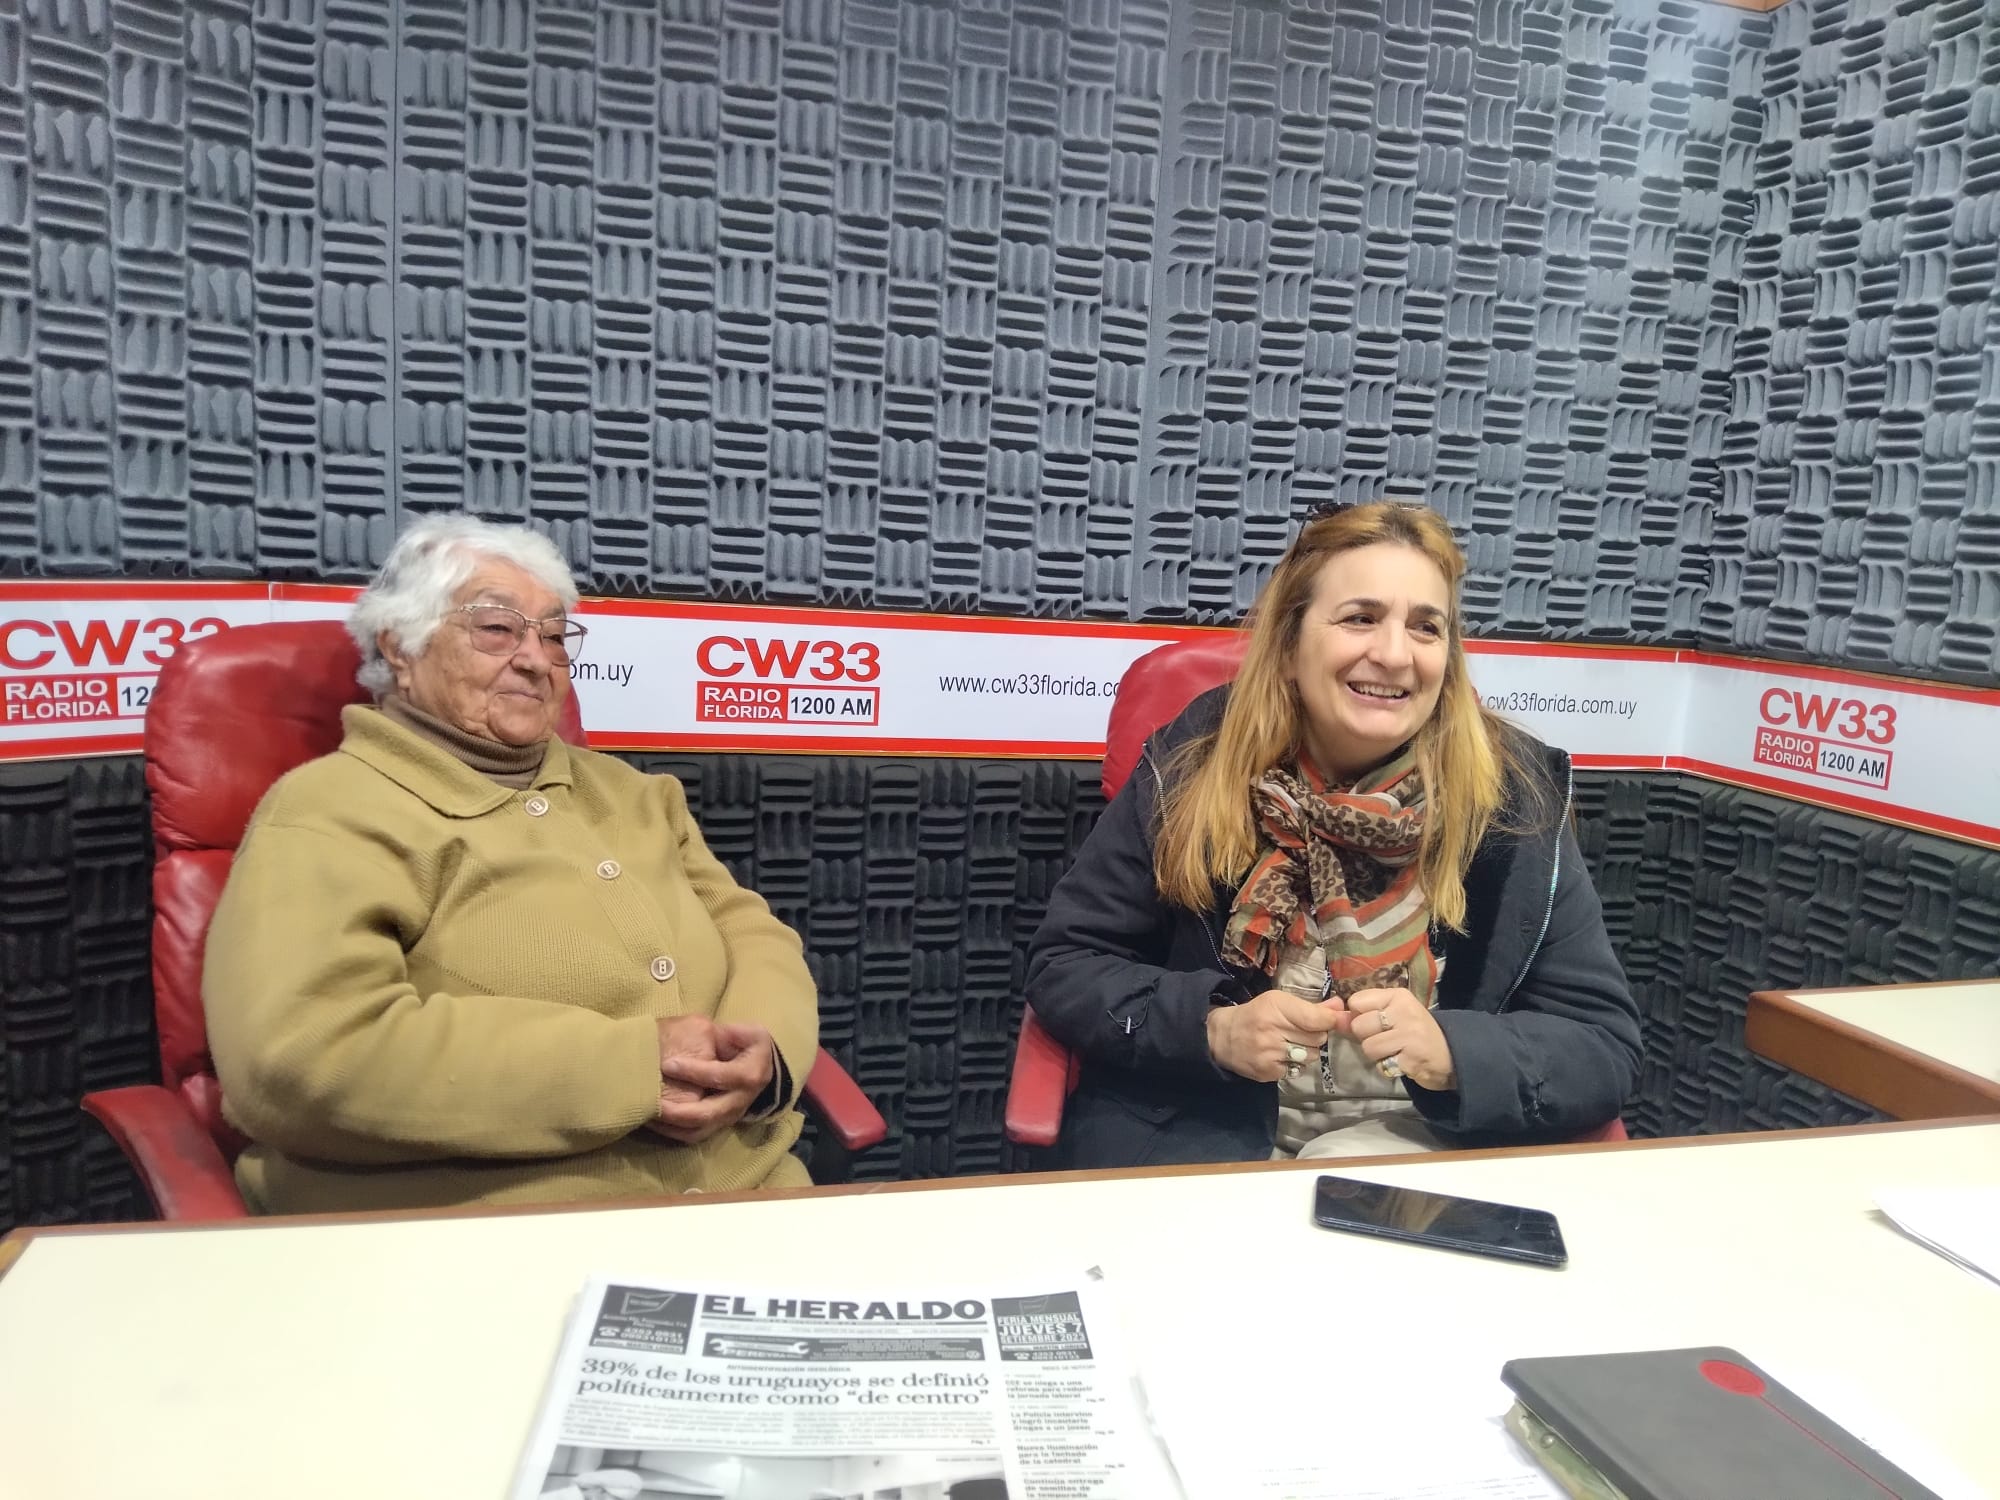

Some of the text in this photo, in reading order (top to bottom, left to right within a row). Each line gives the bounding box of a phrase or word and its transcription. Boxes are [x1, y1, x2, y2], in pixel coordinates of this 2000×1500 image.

[697, 636, 880, 682] CW33
[5, 679, 108, 700] RADIO
[704, 687, 781, 703] RADIO
[6, 700, 112, 720] FLORIDA
[704, 705, 783, 719] FLORIDA
[791, 696, 872, 715] 1200 AM
[1760, 688, 1897, 744] CW33
[1761, 732, 1814, 754] RADIO
[1759, 748, 1813, 769] FLORIDA
[1820, 751, 1885, 779] 1200 AM
[702, 1295, 986, 1320] EL HERALDO
[1029, 1312, 1080, 1324] MENSUAL
[999, 1322, 1066, 1336] JUEVES
[1072, 1322, 1081, 1333] 7
[581, 1358, 989, 1392] 39% de los uruguayos se definió
[576, 1379, 760, 1404] políticamente
[767, 1393, 840, 1406] como
